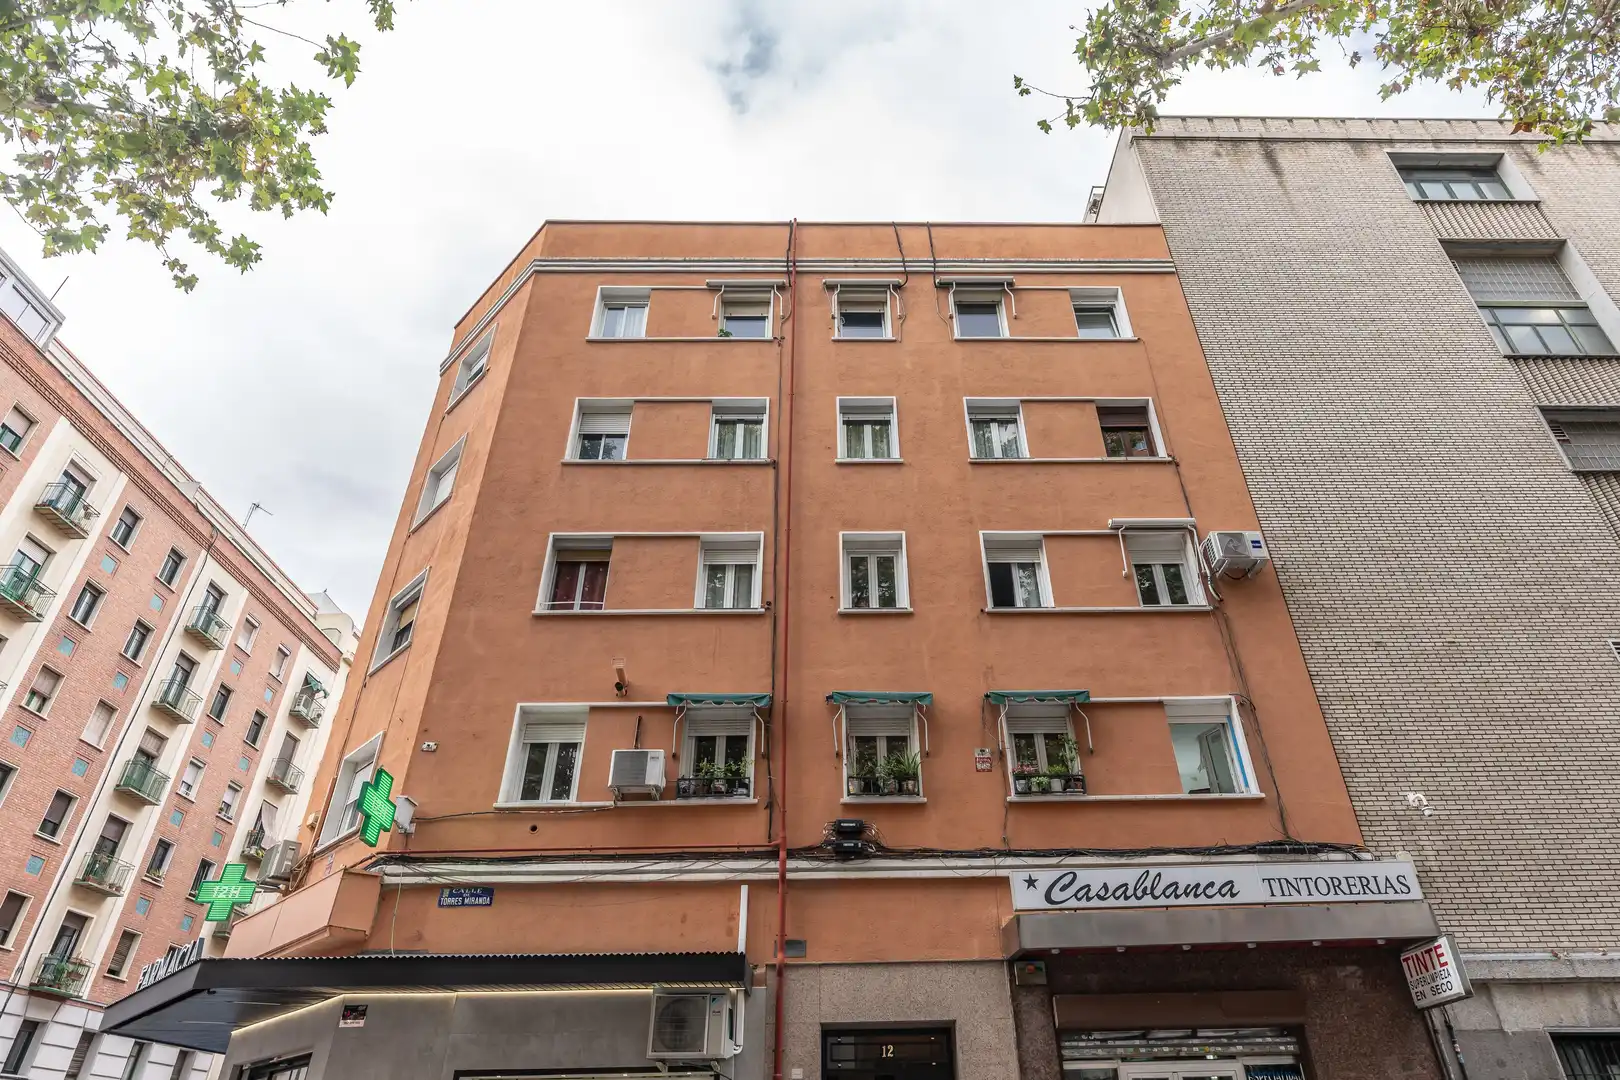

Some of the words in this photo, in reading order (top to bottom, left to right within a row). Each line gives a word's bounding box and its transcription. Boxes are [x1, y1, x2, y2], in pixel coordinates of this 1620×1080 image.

[212, 886, 241, 898] 12H
[1044, 869, 1240, 906] Casablanca
[1262, 874, 1411, 897] TINTORERIAS
[440, 897, 463, 906] TORRES
[464, 896, 490, 905] MIRANDA
[134, 939, 202, 992] FARMACIA
[1402, 943, 1449, 978] TINTE
[1409, 967, 1452, 991] SUPERLIMPIEZA
[1415, 990, 1427, 1001] EN
[1430, 980, 1453, 996] SECO
[881, 1044, 894, 1058] 12
